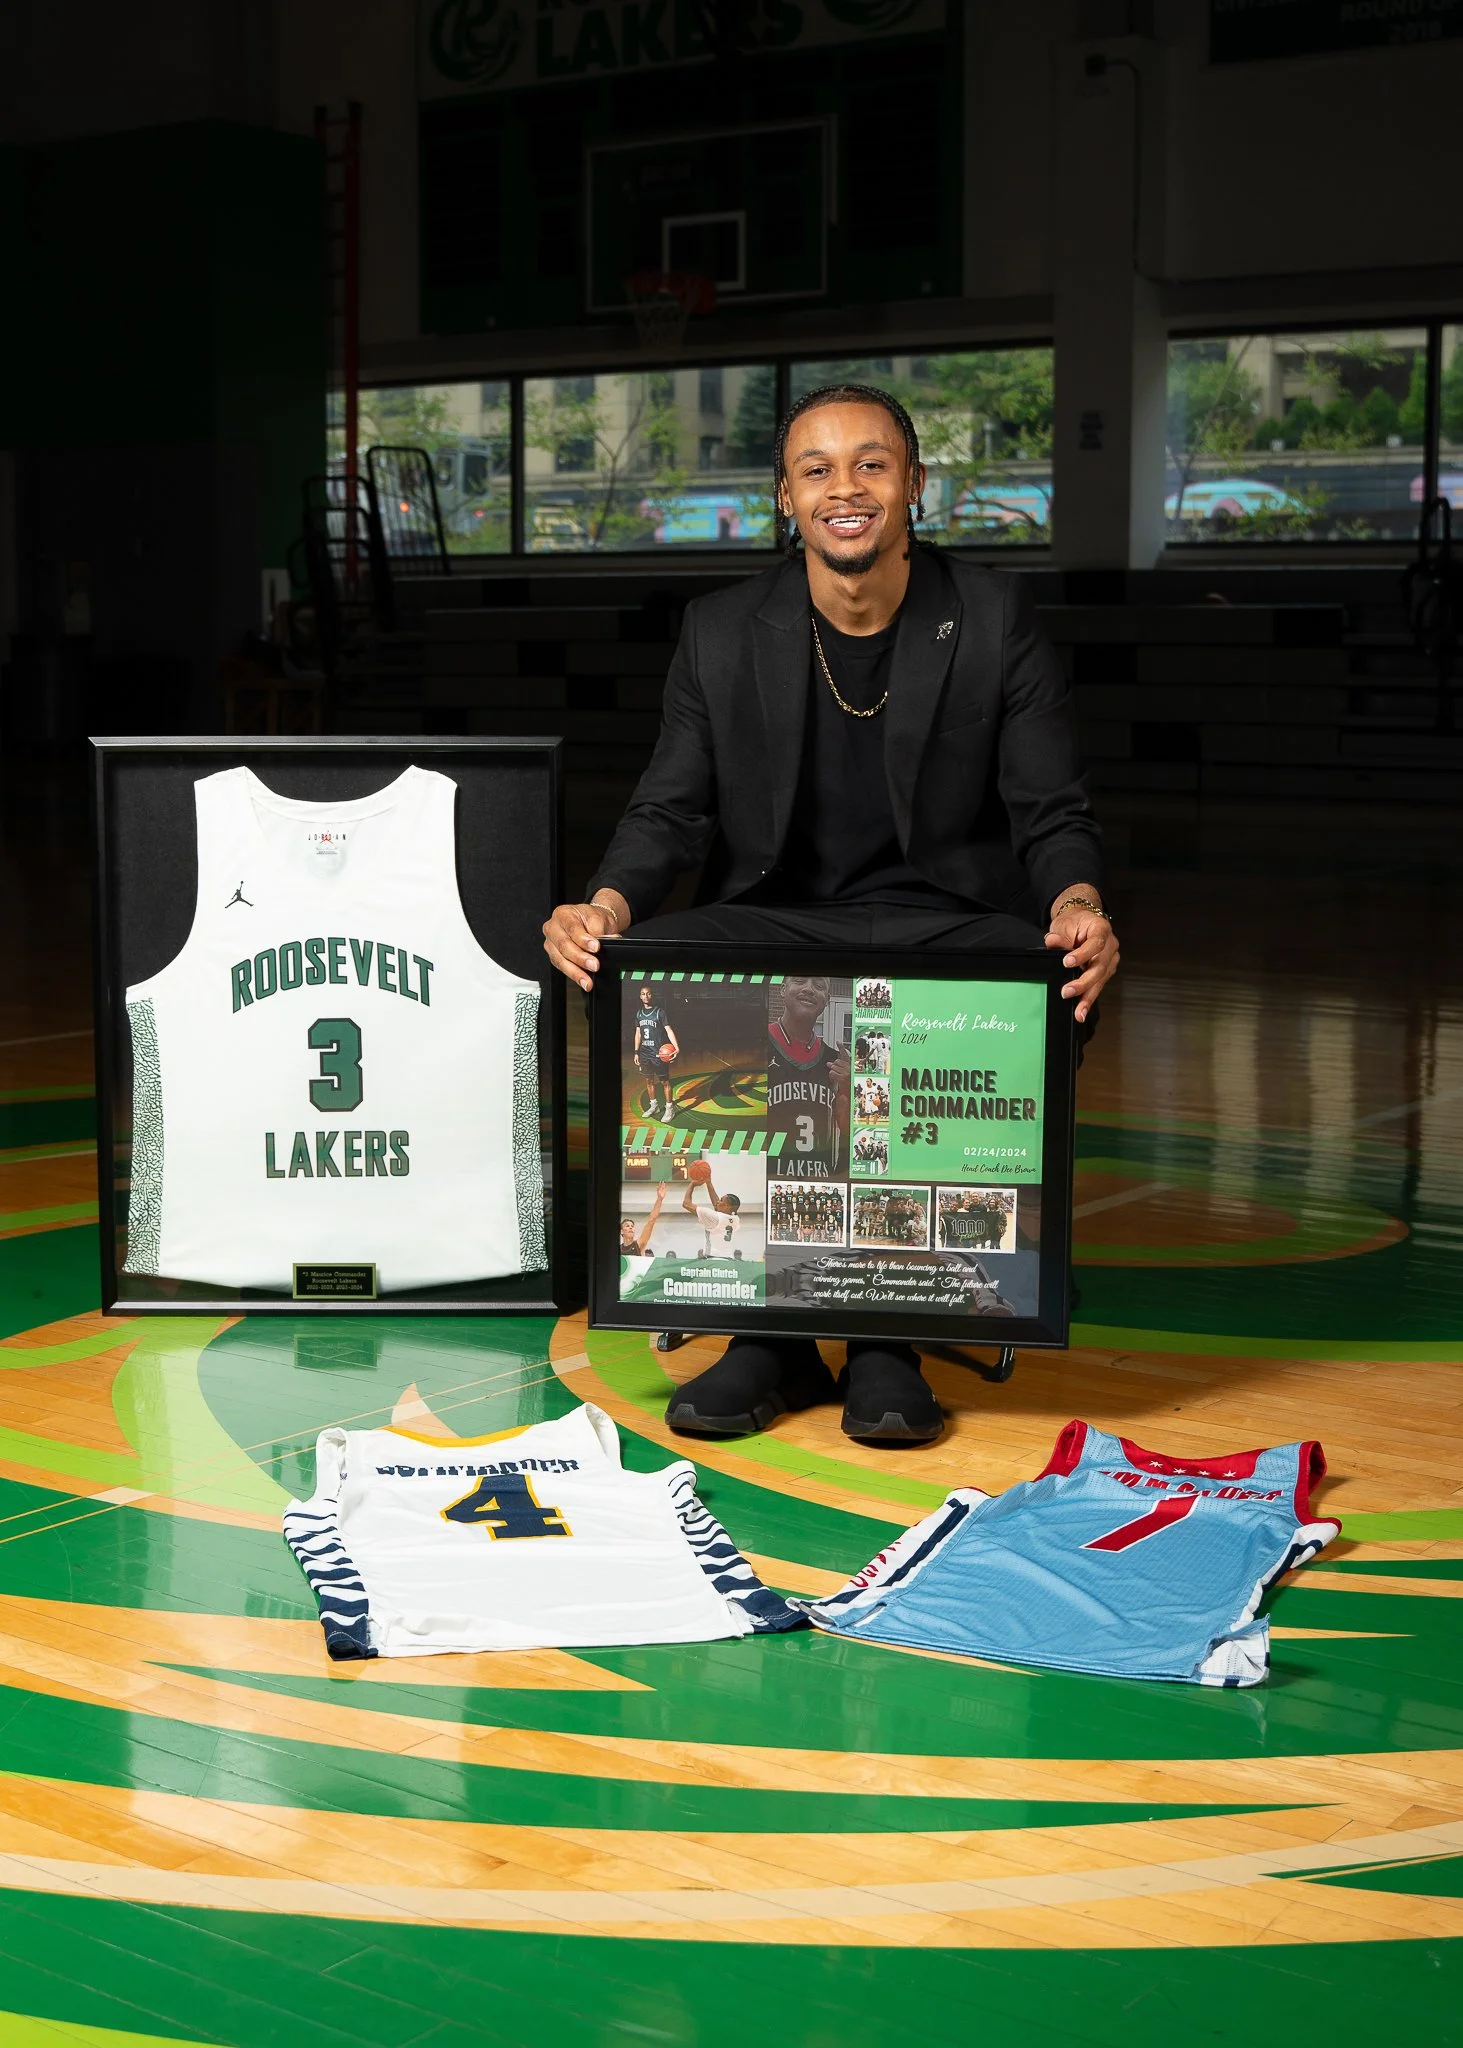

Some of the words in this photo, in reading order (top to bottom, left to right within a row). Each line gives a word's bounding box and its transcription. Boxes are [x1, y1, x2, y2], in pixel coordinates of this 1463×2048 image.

[231, 937, 434, 1014] ROOSEVELT
[901, 1012, 968, 1031] Roosevelt
[972, 1014, 1018, 1032] Lakers
[643, 1028, 650, 1039] 3
[901, 1033, 928, 1045] 2024
[307, 1017, 363, 1113] 3
[901, 1067, 998, 1093] MAURICE
[767, 1081, 836, 1109] ROOSEVEL
[900, 1095, 1037, 1121] COMMANDER
[795, 1115, 814, 1152] 3
[900, 1121, 939, 1145] #3
[265, 1130, 410, 1179] LAKERS
[627, 1158, 649, 1167] PLAYER
[963, 1147, 1027, 1158] 02/24/2024
[961, 1164, 979, 1173] Head
[980, 1162, 1000, 1173] Coach
[1014, 1164, 1036, 1174] Brown
[951, 1219, 985, 1237] 1000
[680, 1266, 711, 1278] Captain
[712, 1268, 739, 1279] Clutch
[867, 1260, 875, 1269] to
[876, 1260, 888, 1273] life
[889, 1261, 905, 1270] than
[906, 1262, 938, 1275] bouncing
[946, 1263, 962, 1272] ball
[962, 1263, 978, 1273] and
[663, 1277, 758, 1299] Commander
[813, 1275, 840, 1286] winning
[872, 1273, 917, 1286] Commander
[960, 1279, 983, 1292] future
[984, 1279, 999, 1289] will
[813, 1289, 831, 1298] work
[833, 1289, 850, 1302] itself
[865, 1288, 895, 1301] We'll
[907, 1293, 926, 1302] where
[928, 1293, 935, 1302] it
[935, 1293, 950, 1303] will
[439, 1472, 574, 1541] 4
